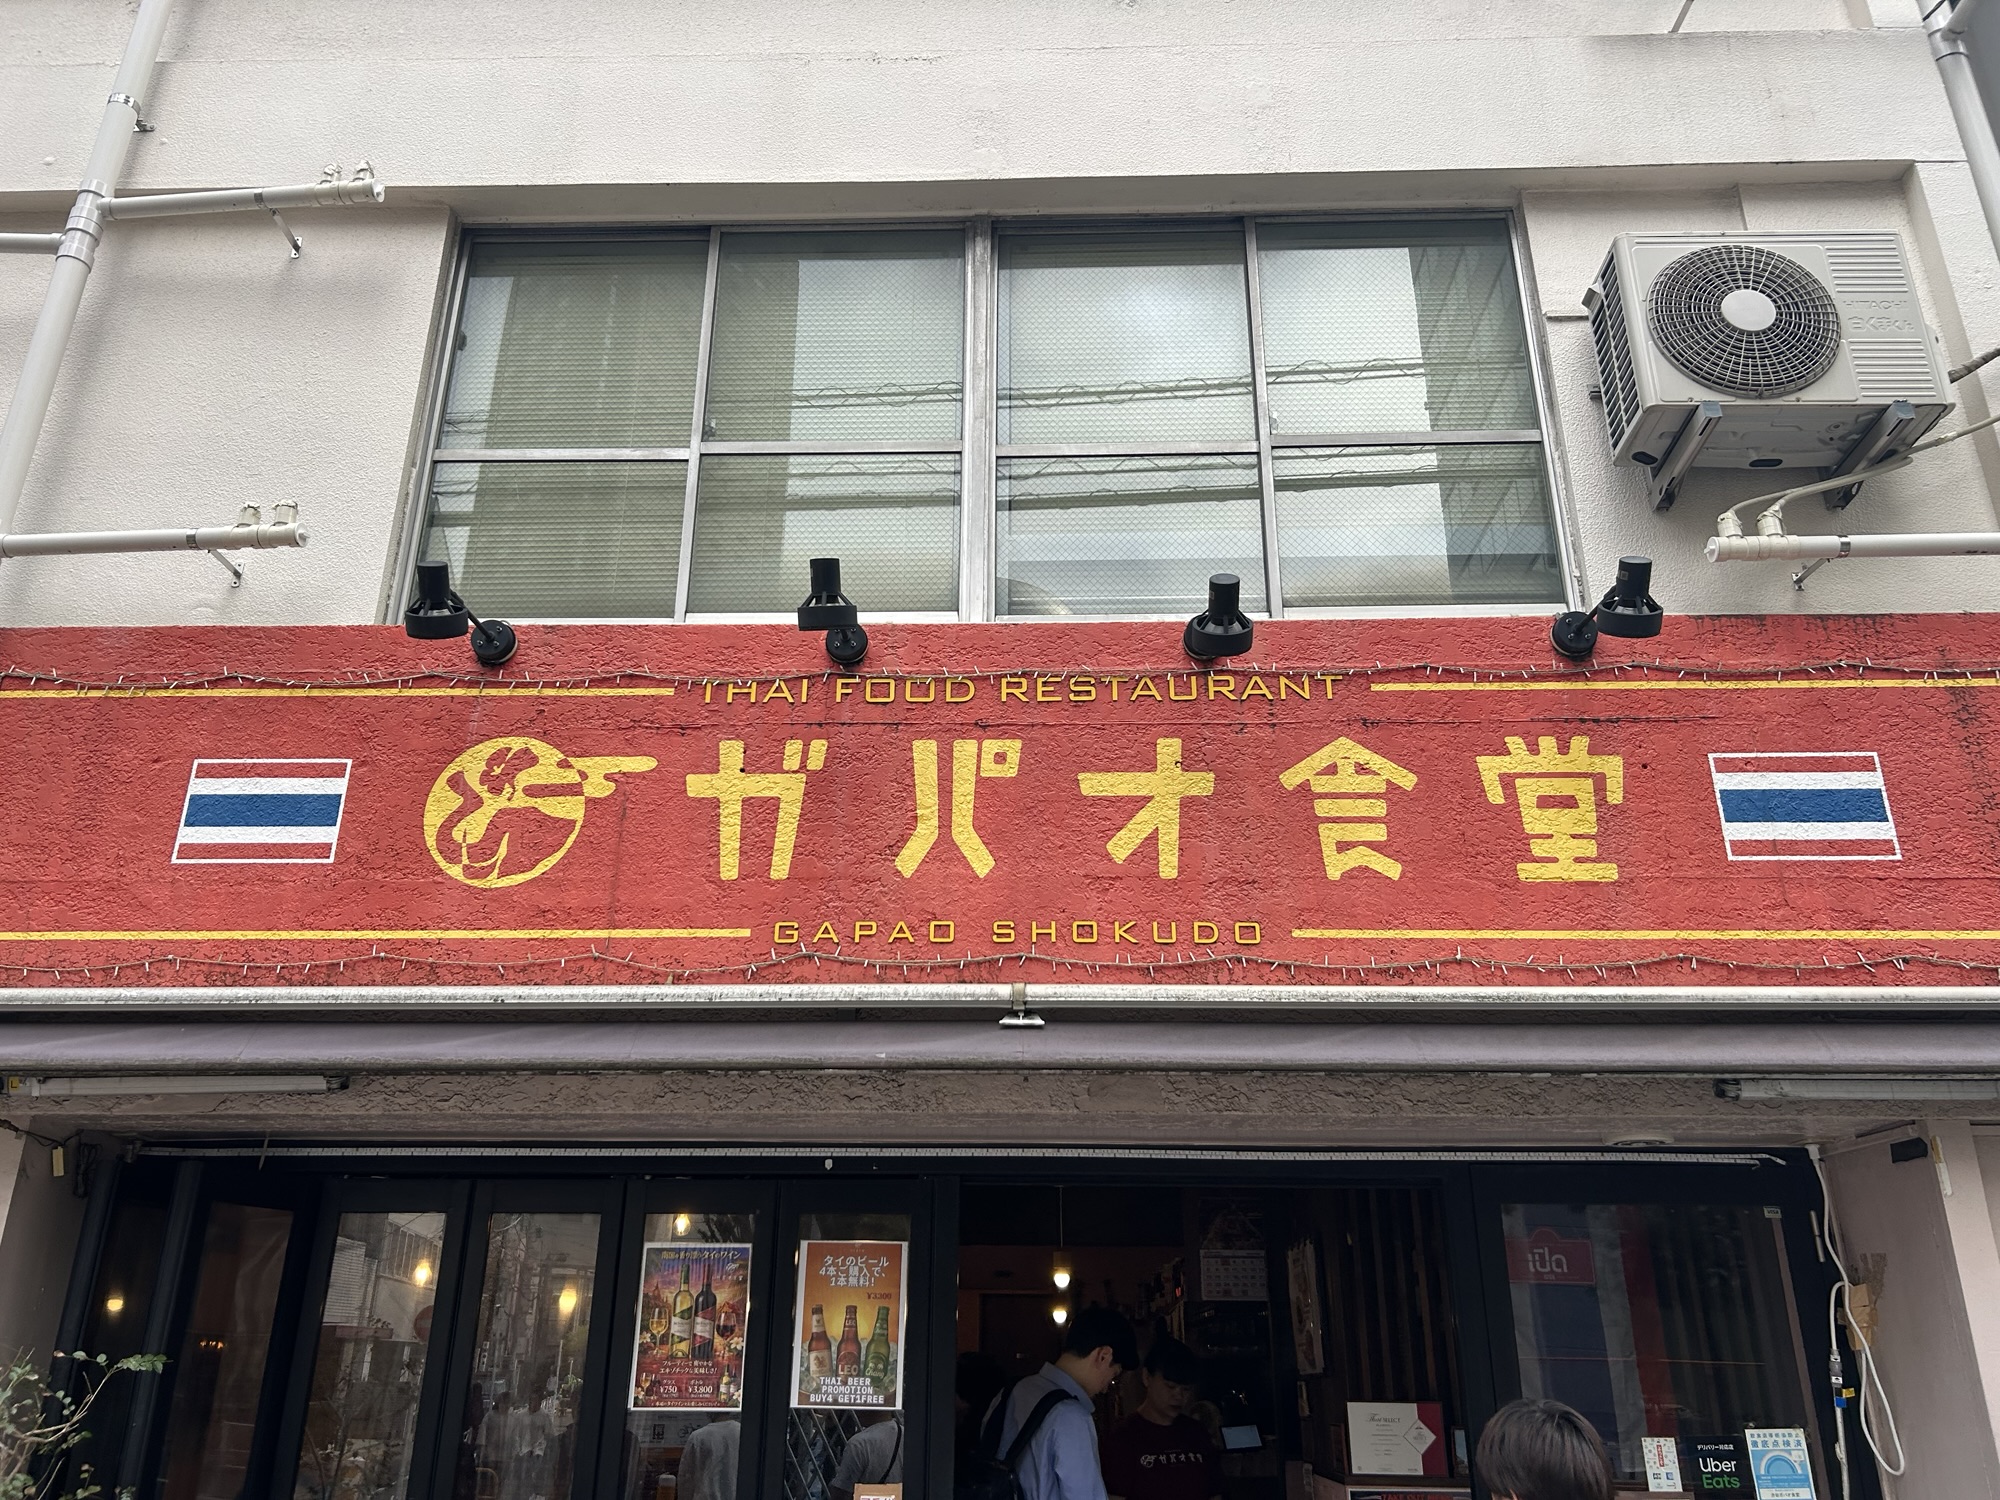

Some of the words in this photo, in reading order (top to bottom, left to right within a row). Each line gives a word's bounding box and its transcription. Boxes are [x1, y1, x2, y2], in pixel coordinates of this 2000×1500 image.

[1843, 300, 1909, 310] HITACHI
[695, 678, 808, 704] THAI
[835, 676, 977, 703] FOOD
[1001, 675, 1343, 701] RESTAURANT
[685, 735, 1624, 883] ガパオ食堂
[773, 920, 957, 945] GAPAO
[991, 919, 1263, 945] SHOKUDO
[824, 1255, 890, 1267] タイのビール
[838, 1364, 859, 1375] LEO
[819, 1376, 842, 1385] THAI
[847, 1377, 871, 1386] BEER
[821, 1385, 873, 1394] PROMOTION
[809, 1393, 833, 1402] BUY4
[838, 1394, 885, 1404] GET1FREE
[1699, 1457, 1737, 1473] Uber
[1702, 1474, 1741, 1489] Eats
